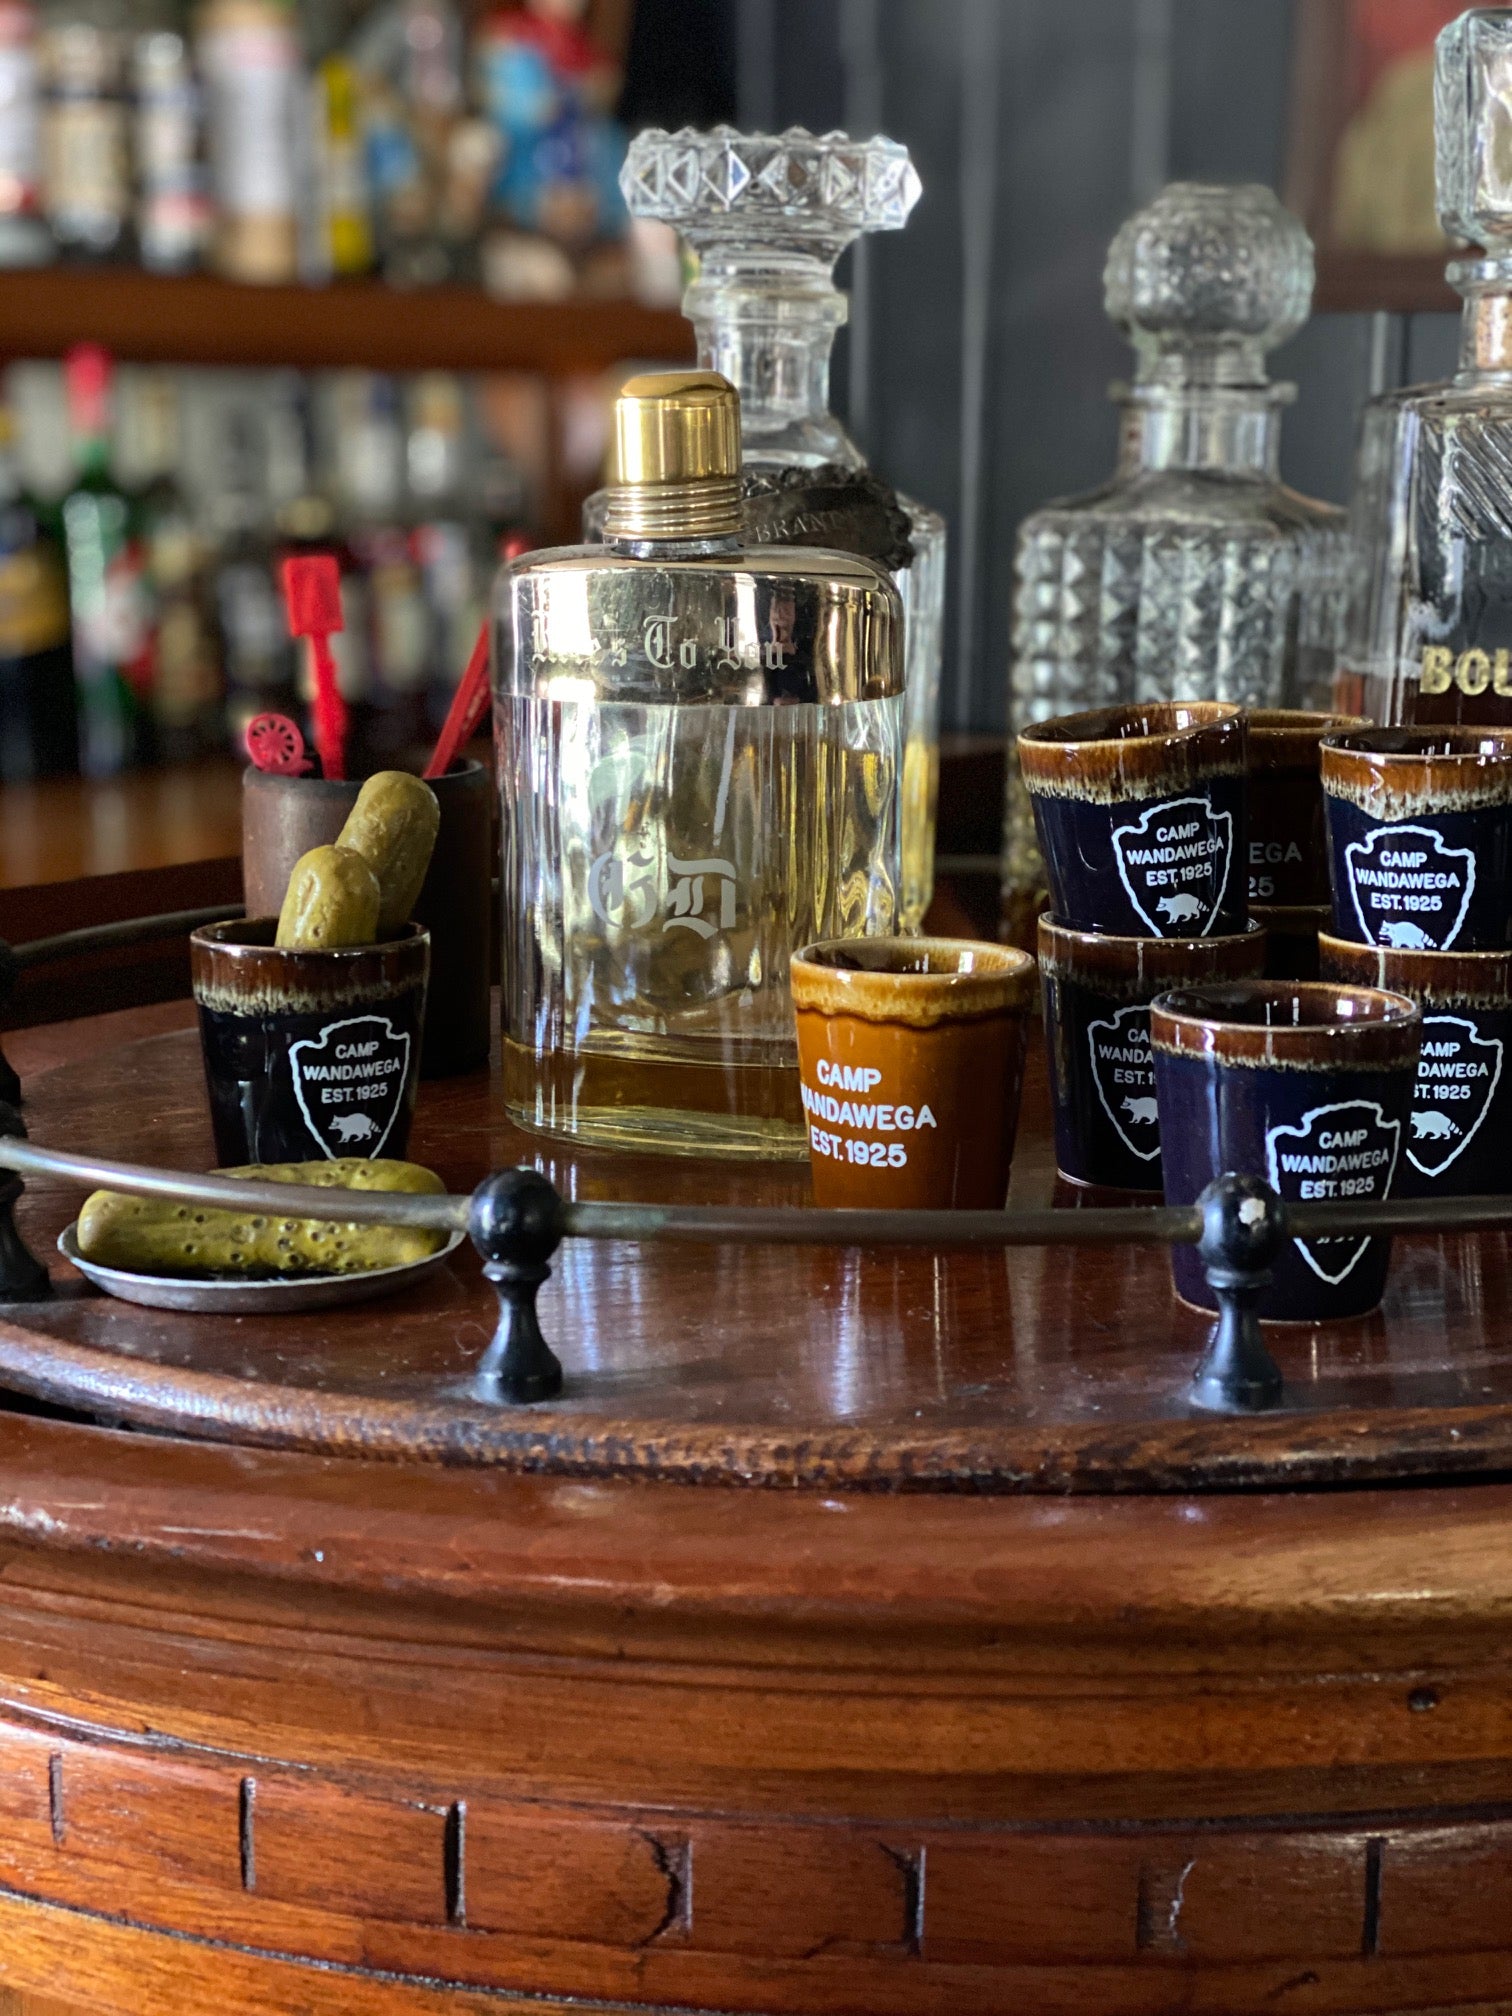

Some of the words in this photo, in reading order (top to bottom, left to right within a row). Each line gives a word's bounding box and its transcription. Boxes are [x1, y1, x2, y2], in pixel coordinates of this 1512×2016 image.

[643, 614, 697, 670] To
[1156, 822, 1200, 843] CAMP
[1127, 836, 1225, 866] WANDAWEGA
[1380, 850, 1428, 868] CAMP
[1355, 867, 1460, 889] WANDAWEGA
[1127, 1028, 1150, 1043] CA
[335, 1041, 379, 1059] CAMP
[1098, 1044, 1154, 1064] WANDA
[302, 1057, 401, 1081] WANDAWEGA
[816, 1058, 882, 1093] CAMP
[1417, 1062, 1489, 1078] DAWEGA
[1318, 1129, 1368, 1149] CAMP
[1280, 1148, 1390, 1174] WANDAWEGA
